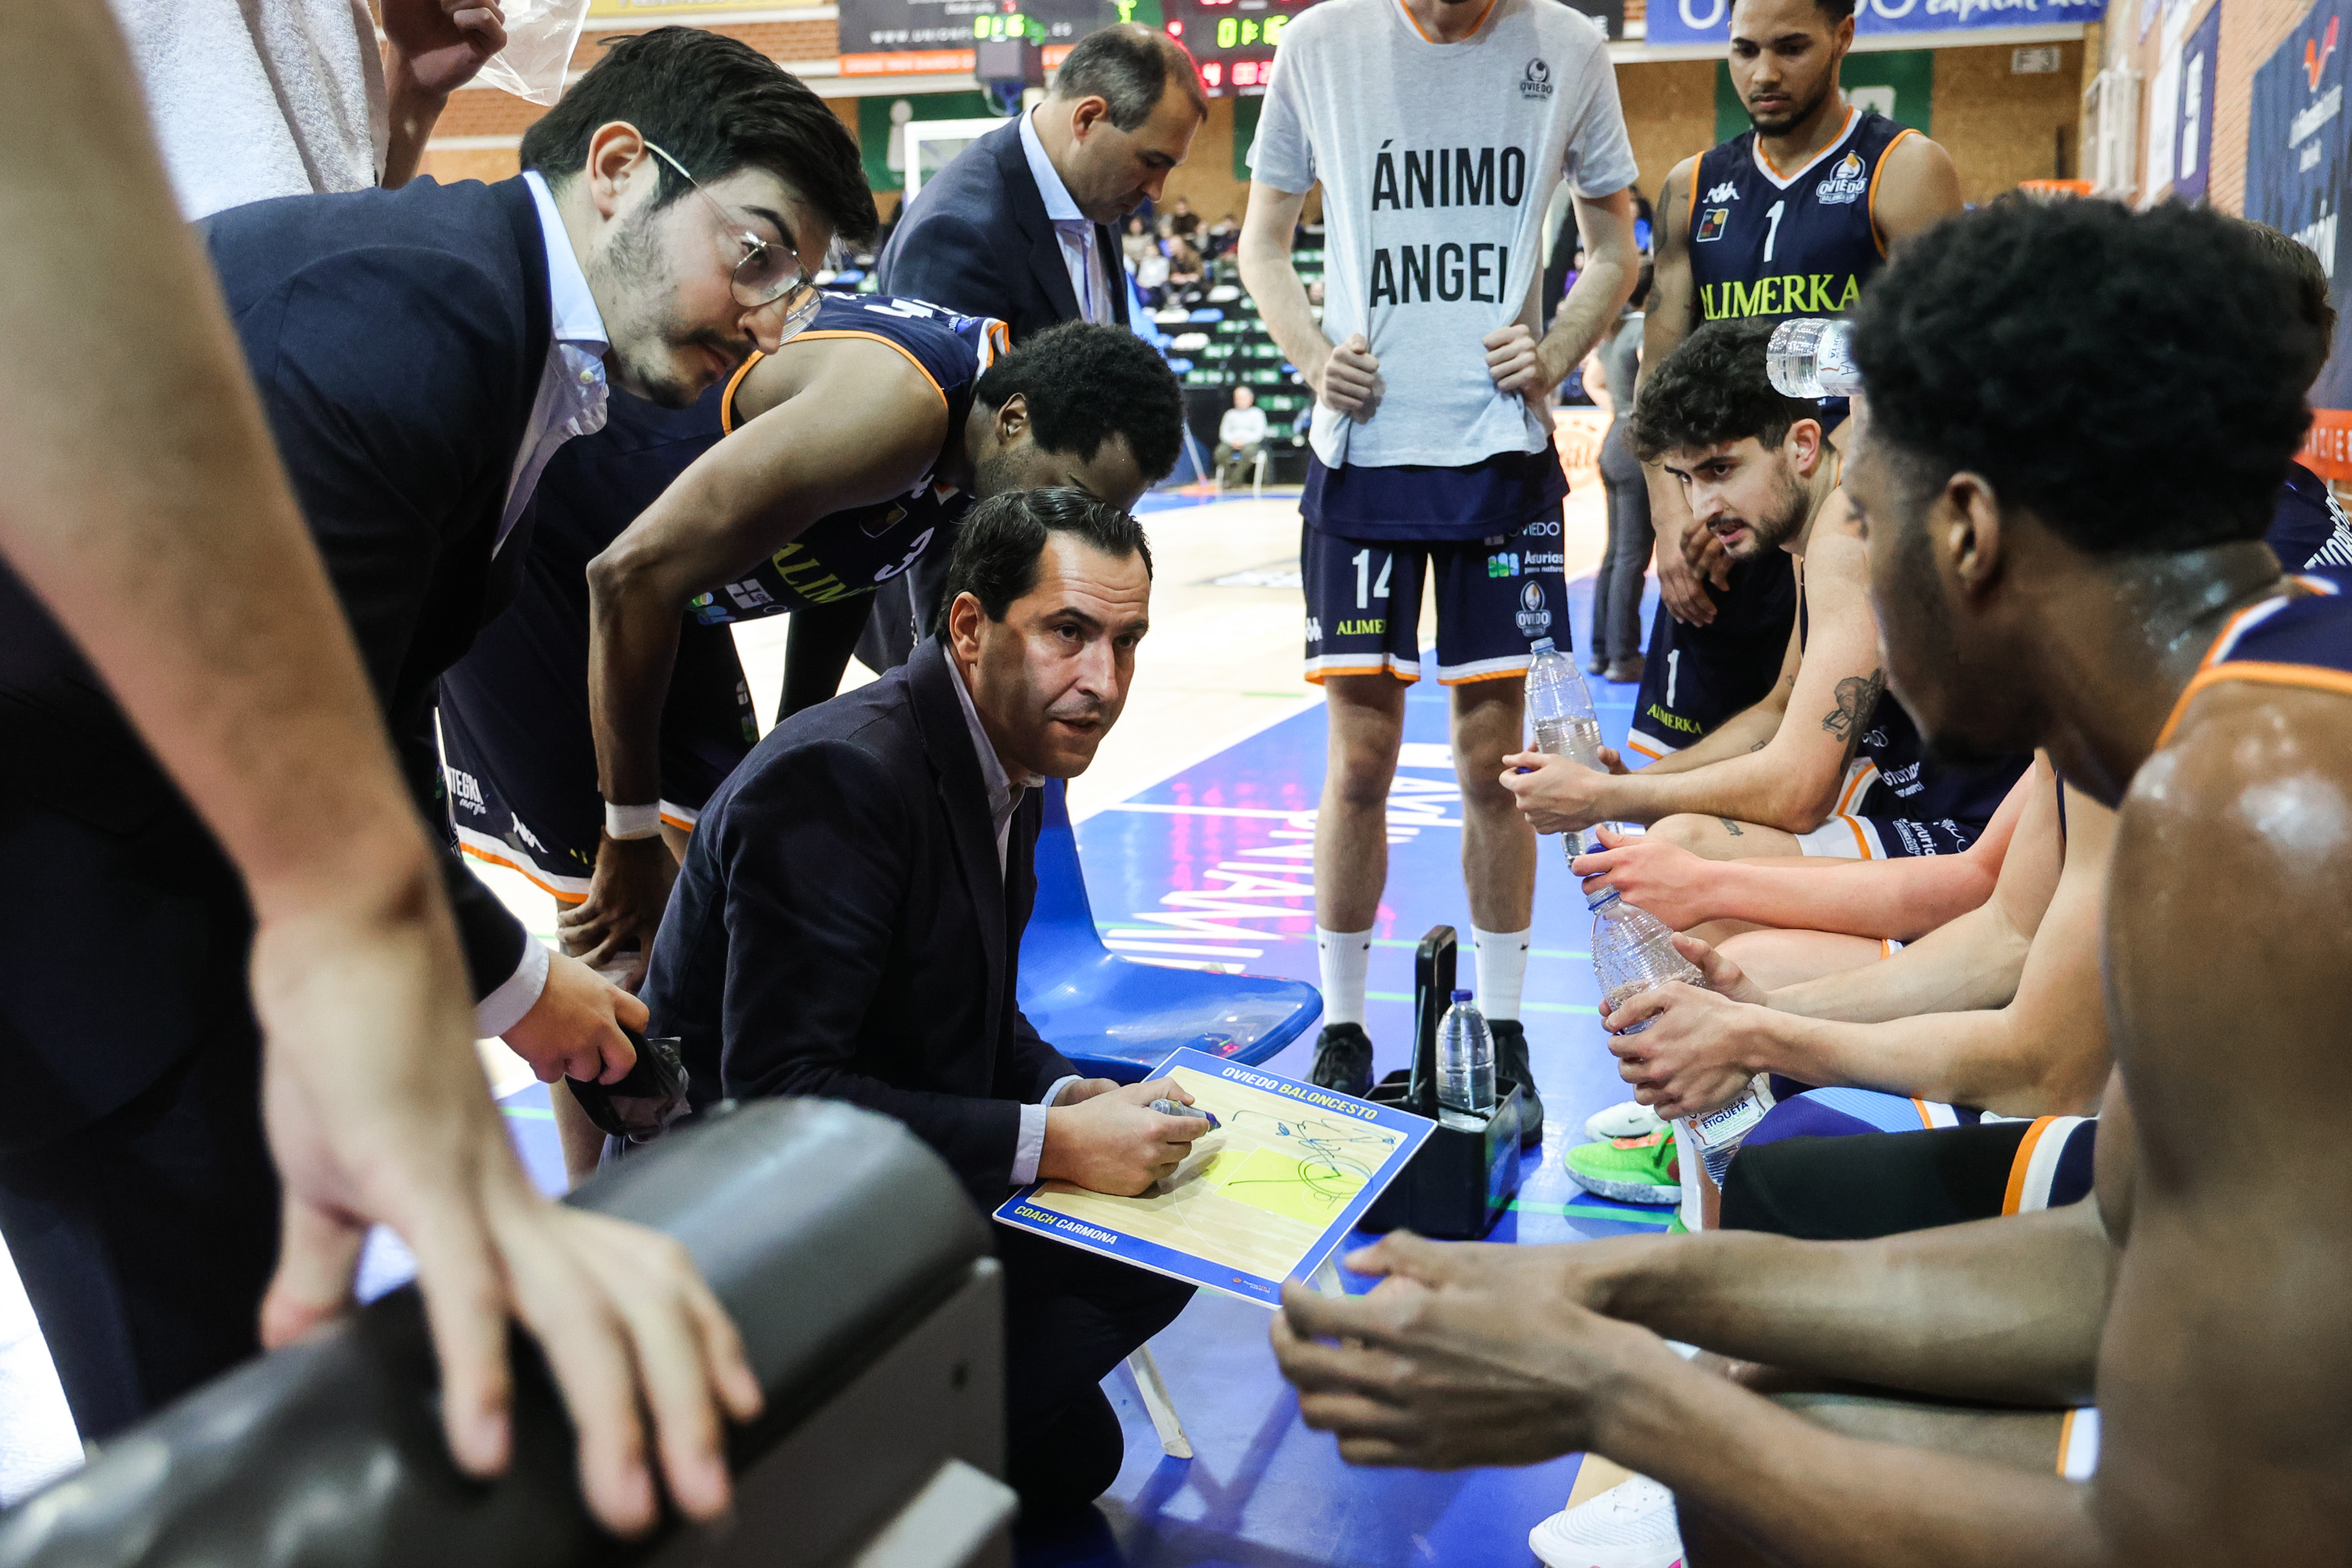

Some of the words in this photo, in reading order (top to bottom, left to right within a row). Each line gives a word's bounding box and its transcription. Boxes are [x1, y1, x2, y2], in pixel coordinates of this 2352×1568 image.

[1520, 82, 1552, 93] OVIEDO
[1372, 139, 1526, 211] ÁNIMO
[1818, 180, 1866, 194] OVIEDO
[1763, 200, 1785, 263] 1
[1352, 548, 1392, 610] 14
[1666, 648, 1680, 709] 1
[1221, 1066, 1279, 1090] OVIEDO
[1278, 1083, 1378, 1120] BALONCESTO
[1703, 1102, 1749, 1129] ETIQUETA
[1724, 1102, 1737, 1111] VOY
[1014, 1205, 1058, 1225] COACH
[1055, 1218, 1118, 1245] CARMONA
